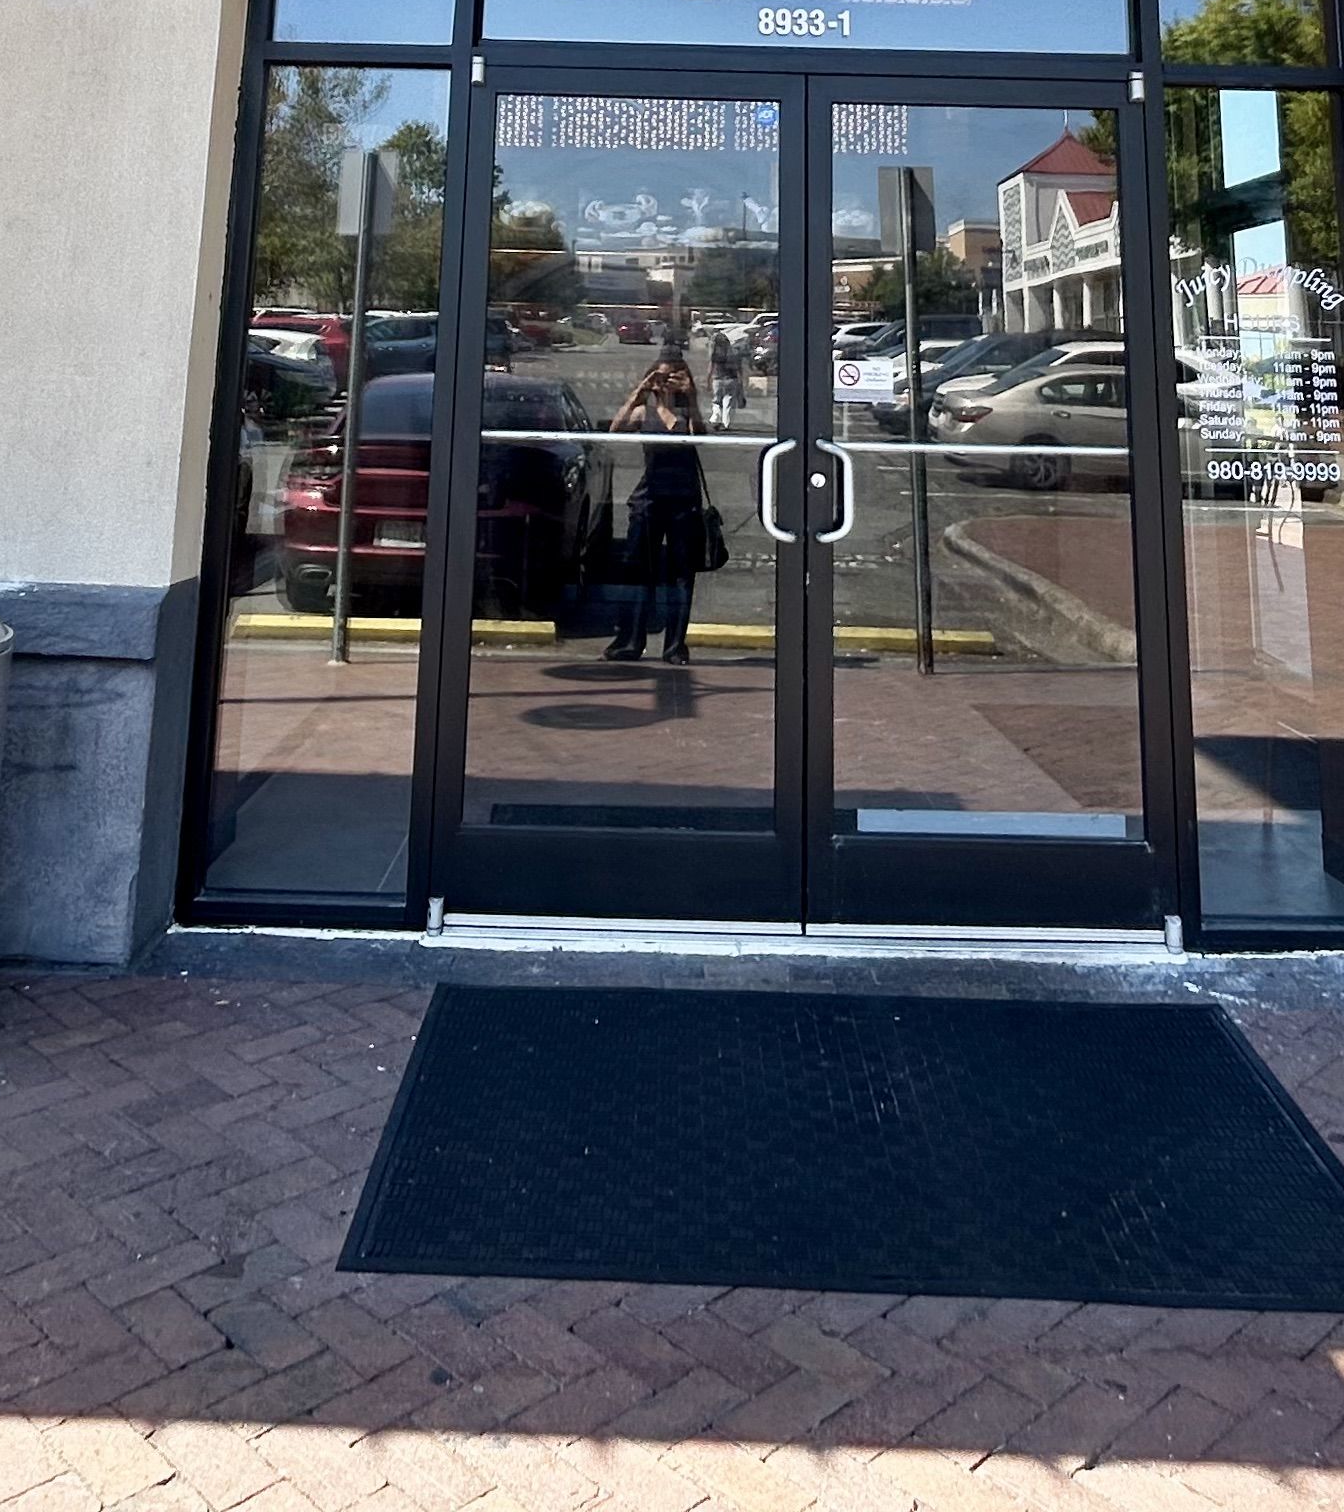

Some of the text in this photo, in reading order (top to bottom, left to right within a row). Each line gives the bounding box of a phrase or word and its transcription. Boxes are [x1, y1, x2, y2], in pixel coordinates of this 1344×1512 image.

[758, 7, 851, 37] 8933-1
[1175, 262, 1231, 308] Juicy
[1223, 311, 1301, 334] HOURS
[1311, 349, 1335, 364] 9pm
[1273, 361, 1302, 373] 11am
[1311, 363, 1336, 377] 9pm
[1312, 376, 1337, 389] 9pm
[1313, 389, 1338, 403] 9pm
[1309, 403, 1339, 417] 11pm
[1310, 417, 1340, 430] 11pm
[1316, 431, 1341, 445] 9pm
[1207, 460, 1341, 482] 980-819-9999
